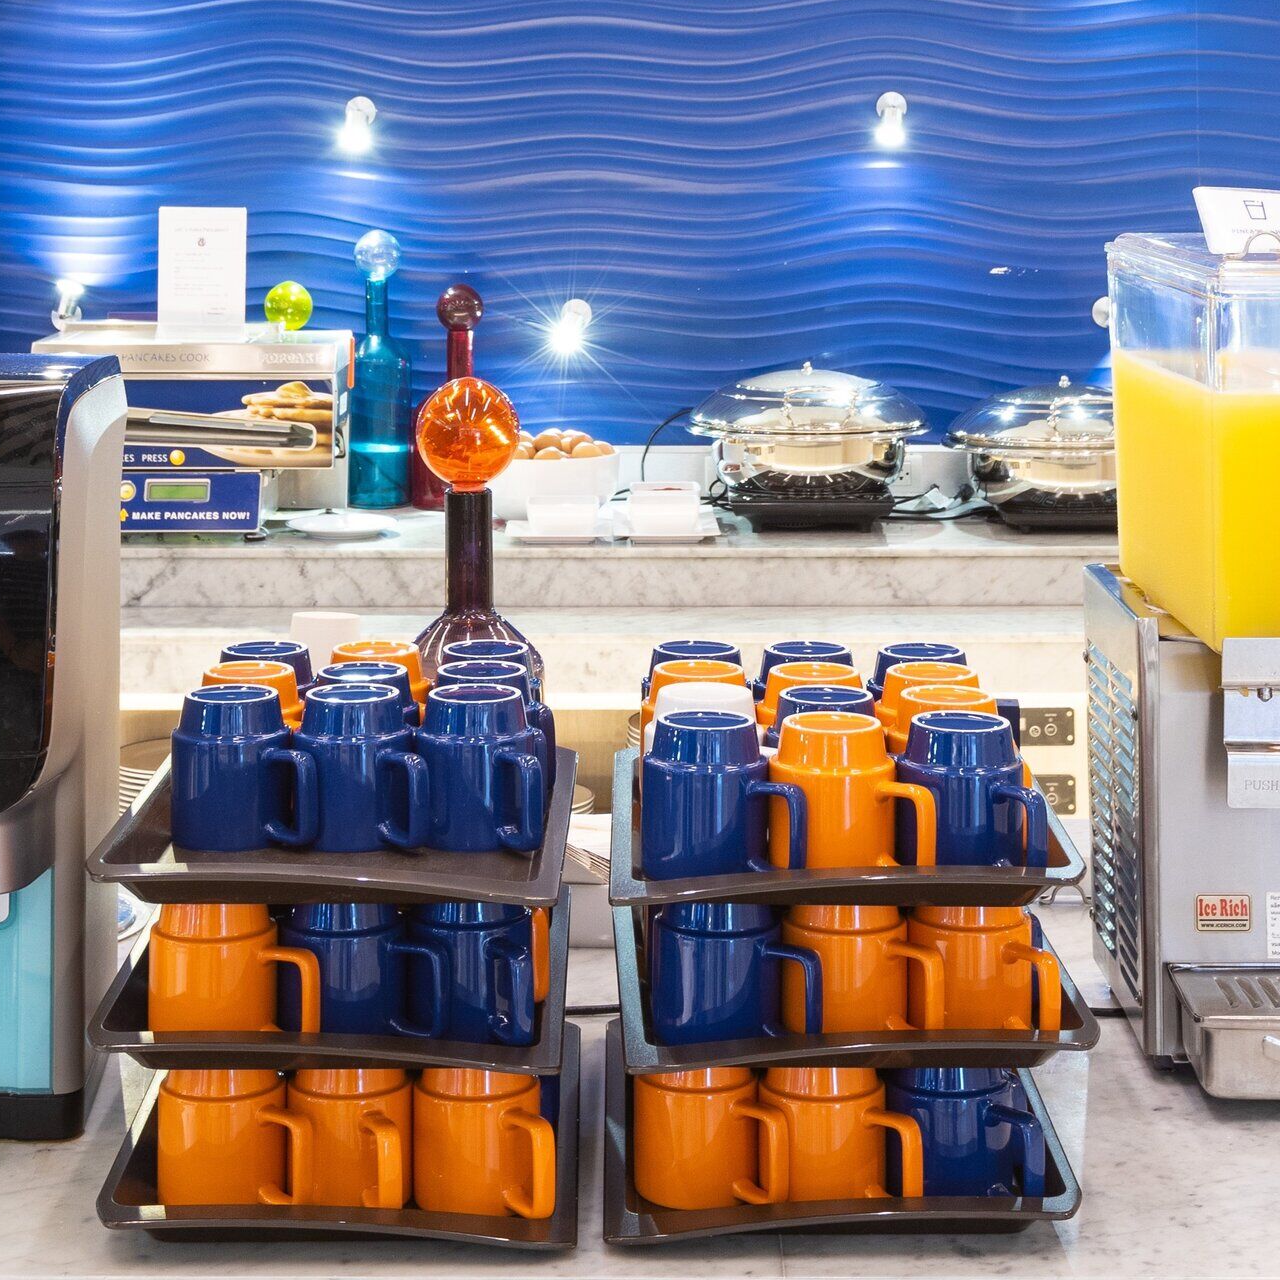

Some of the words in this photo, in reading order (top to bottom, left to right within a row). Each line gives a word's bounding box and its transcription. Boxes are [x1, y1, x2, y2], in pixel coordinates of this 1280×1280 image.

[179, 352, 210, 362] COOK
[141, 453, 168, 463] PRESS
[132, 511, 161, 520] MAKE
[163, 511, 220, 520] PANCAKES
[222, 511, 250, 520] NOW!
[1244, 780, 1279, 791] PUSH
[1199, 899, 1217, 917] Ice
[1220, 899, 1248, 917] Rich
